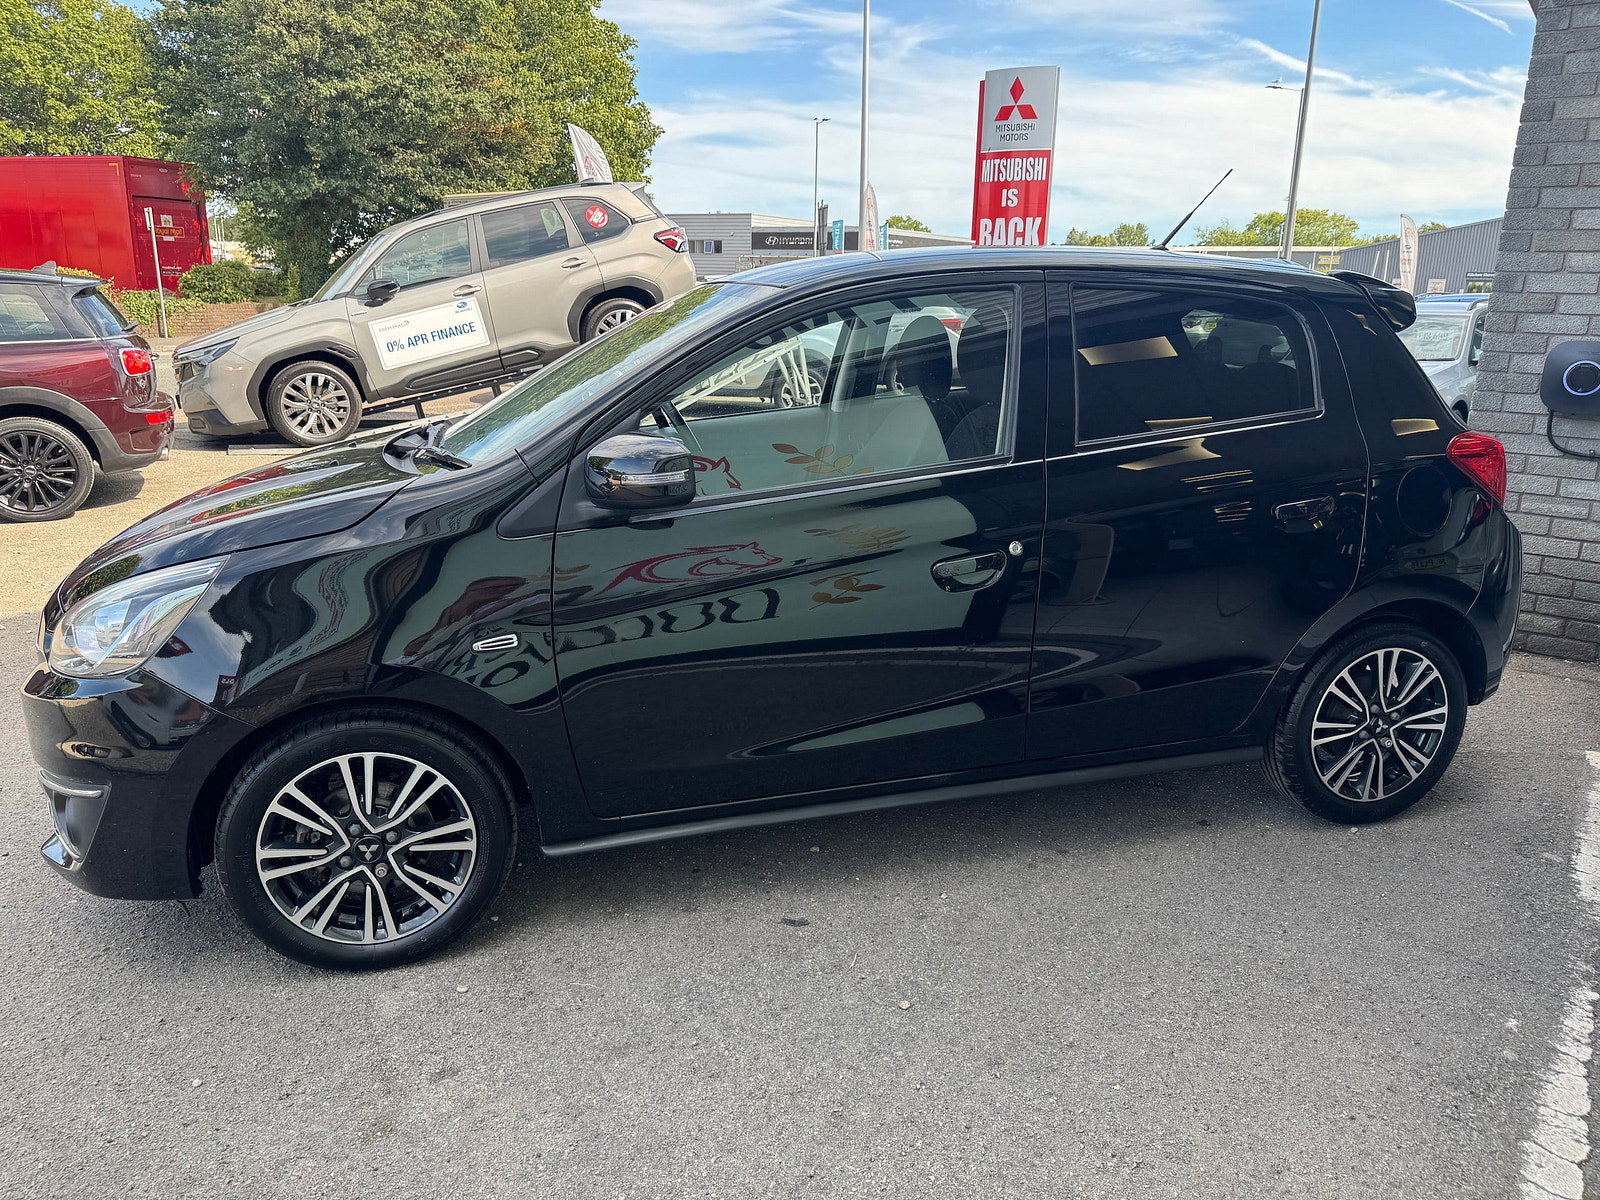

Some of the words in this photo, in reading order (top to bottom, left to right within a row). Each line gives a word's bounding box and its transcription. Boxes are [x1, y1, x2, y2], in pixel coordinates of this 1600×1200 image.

[995, 122, 1036, 133] MITSUBISHI
[999, 132, 1029, 142] MOTORS
[982, 158, 1047, 182] MITSUBISHI
[1001, 188, 1019, 207] IS
[779, 236, 813, 245] HYUNDAI
[980, 218, 1042, 246] BACK
[387, 339, 404, 352] 0%
[407, 333, 429, 347] APR
[431, 322, 476, 341] FINANCE
